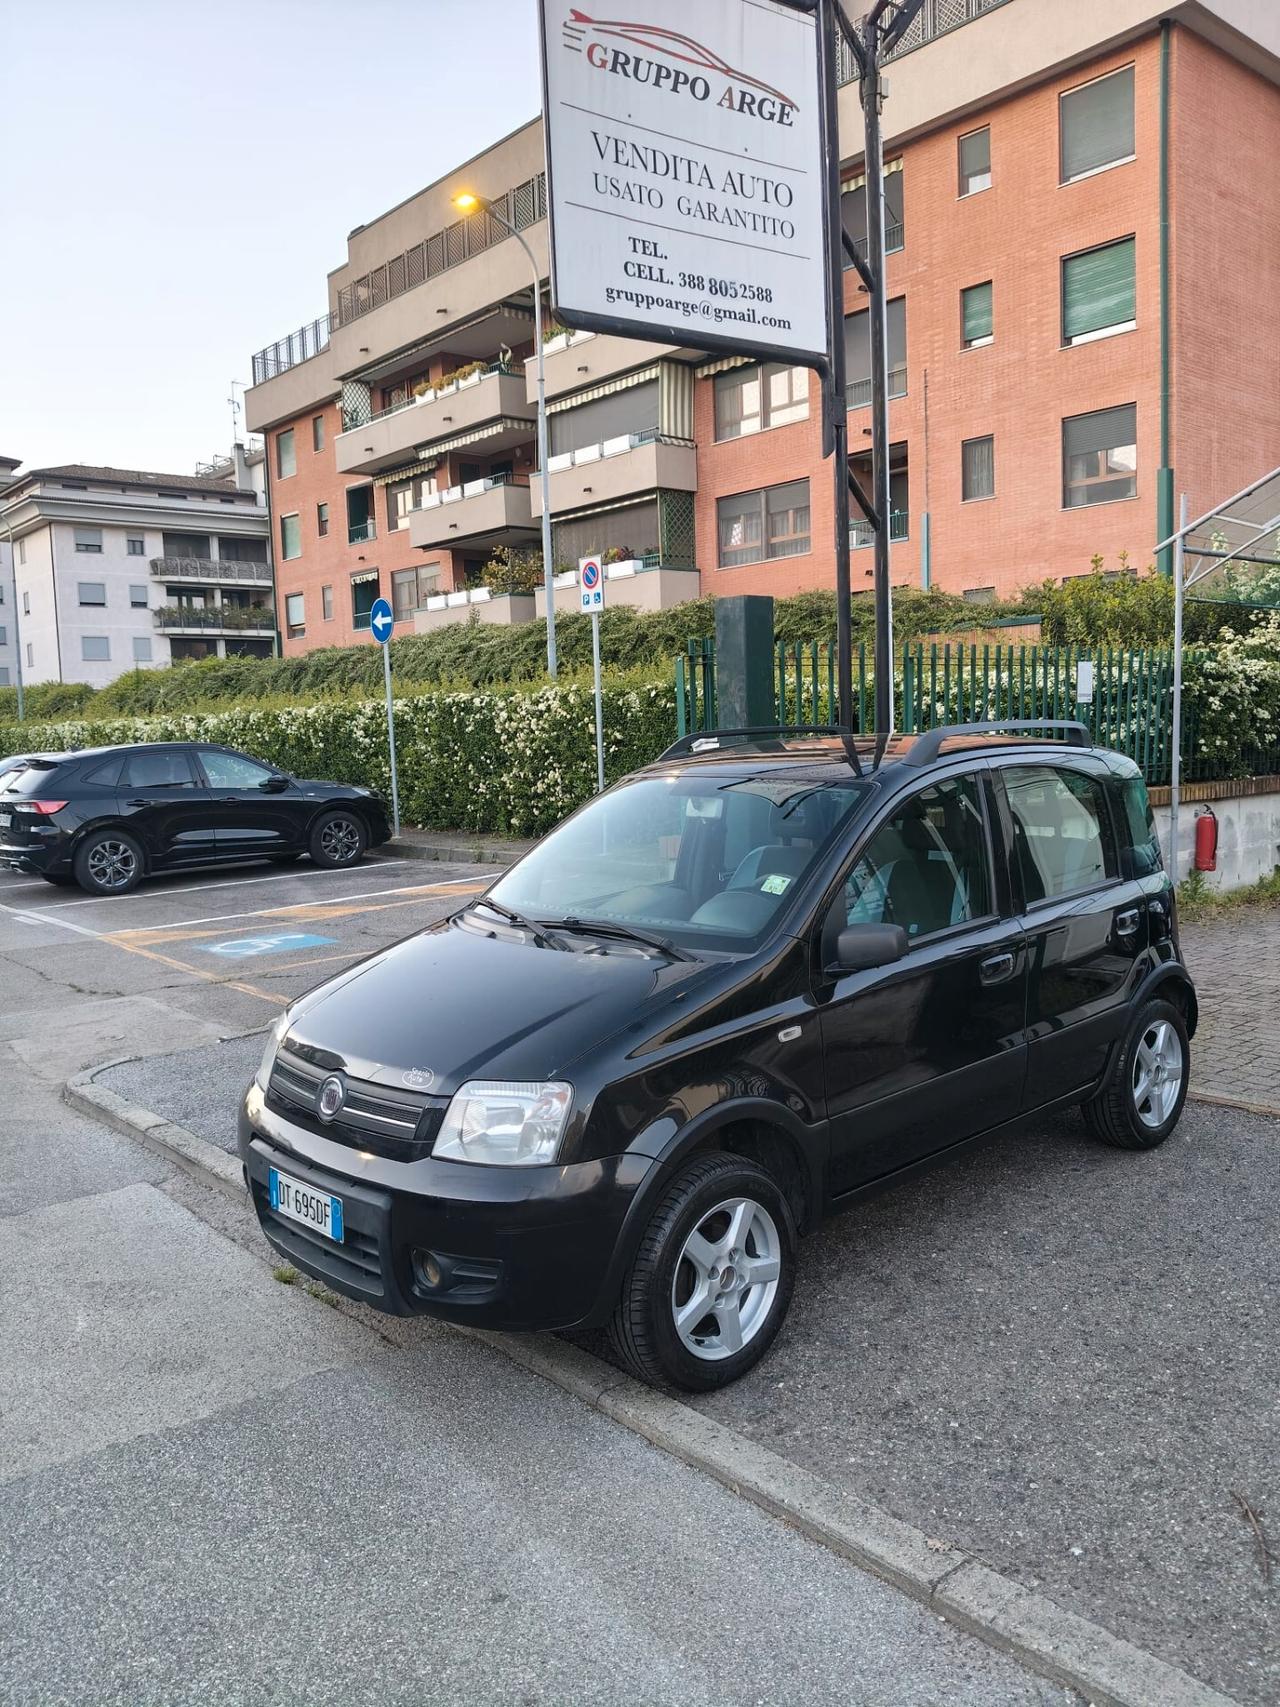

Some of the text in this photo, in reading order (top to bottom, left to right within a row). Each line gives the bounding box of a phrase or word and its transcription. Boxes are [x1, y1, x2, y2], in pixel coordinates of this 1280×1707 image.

[586, 42, 794, 126] GRUPPO ARGE
[590, 130, 793, 208] VENDITA AUTO
[592, 171, 795, 240] USATO GARANTITO
[627, 235, 669, 261] TEL.
[622, 260, 675, 286] CELL.
[678, 271, 706, 292] 388
[605, 287, 792, 330] gruppoarge@gmail.com
[279, 1180, 331, 1228] DT 695DF
